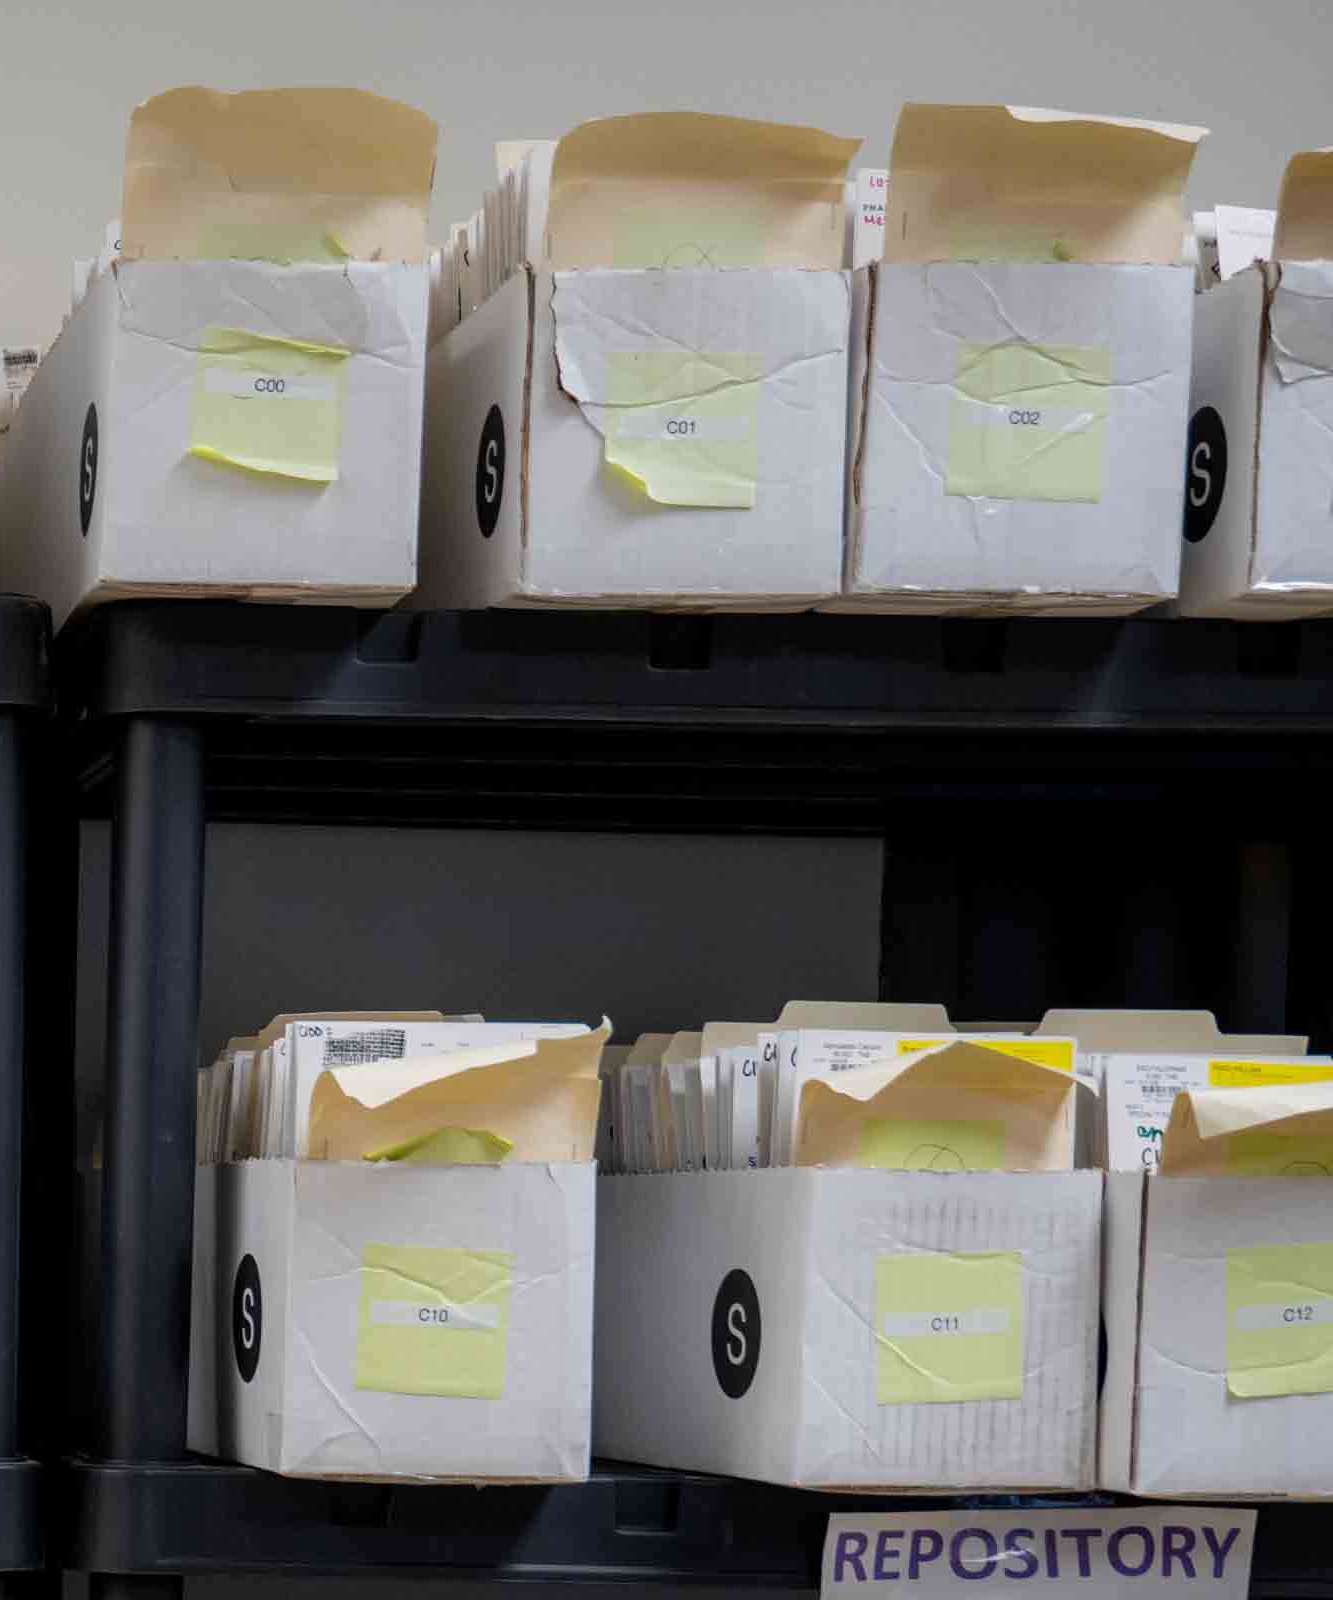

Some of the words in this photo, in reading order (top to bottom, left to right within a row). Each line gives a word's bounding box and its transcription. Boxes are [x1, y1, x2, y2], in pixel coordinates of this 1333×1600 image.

[254, 378, 285, 393] C00
[1008, 410, 1040, 425] C02
[666, 420, 696, 434] C01
[484, 439, 497, 503] S
[1190, 441, 1212, 506] S
[241, 1287, 254, 1349] S
[418, 1308, 449, 1323] C10
[1283, 1306, 1313, 1323] C12
[931, 1317, 959, 1331] C11
[727, 1303, 746, 1365] S
[834, 1525, 1241, 1582] REPOSITORY
